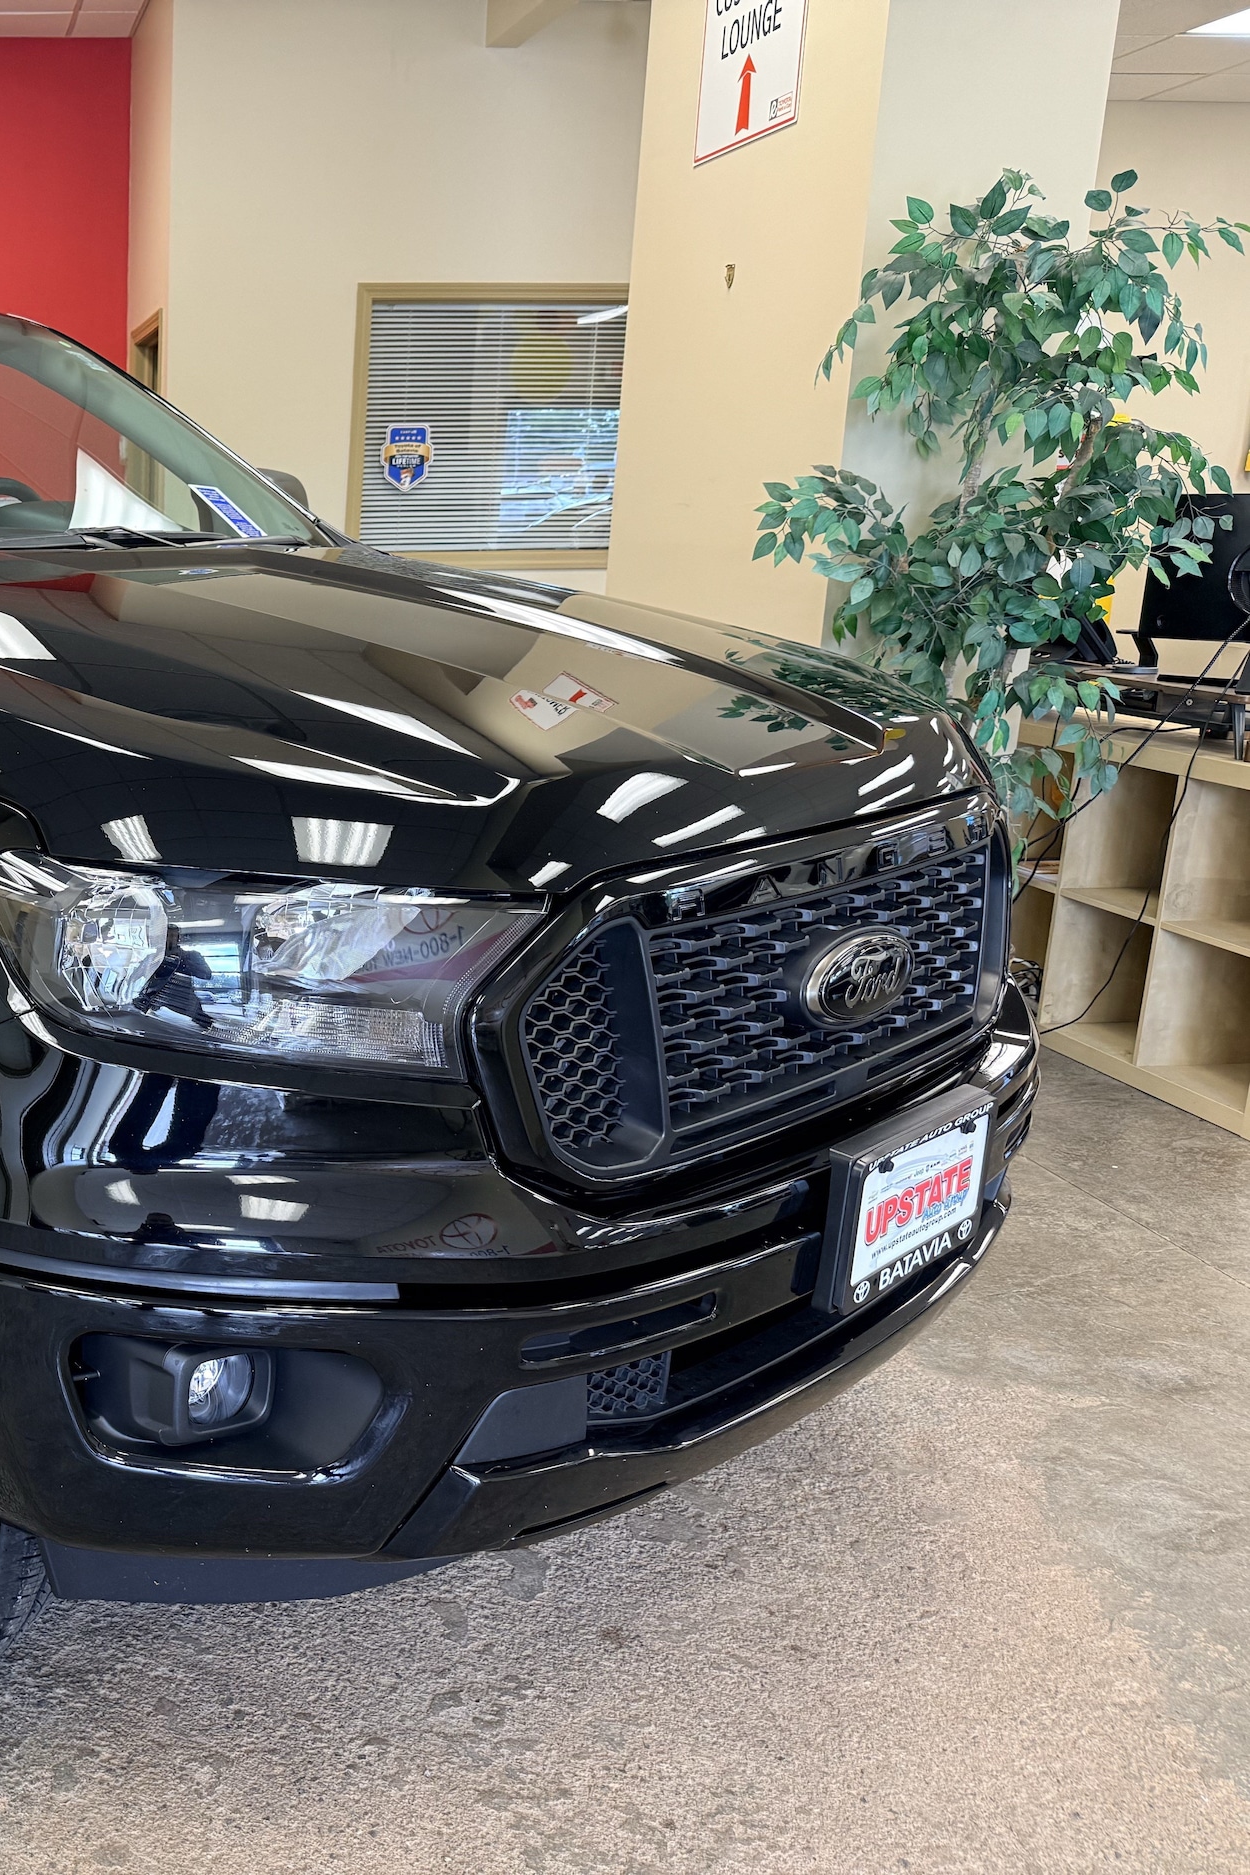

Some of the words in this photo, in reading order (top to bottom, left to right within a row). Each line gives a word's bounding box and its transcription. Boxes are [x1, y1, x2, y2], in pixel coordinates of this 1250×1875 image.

[721, 0, 782, 60] LOUNGE
[845, 948, 902, 1008] Ford
[920, 1122, 953, 1141] AUTO
[954, 1101, 994, 1127] GROUP
[864, 1155, 973, 1247] UPSTATE
[871, 1208, 956, 1259] www.upstateautogroup.com
[878, 1232, 952, 1291] BATAVIA
